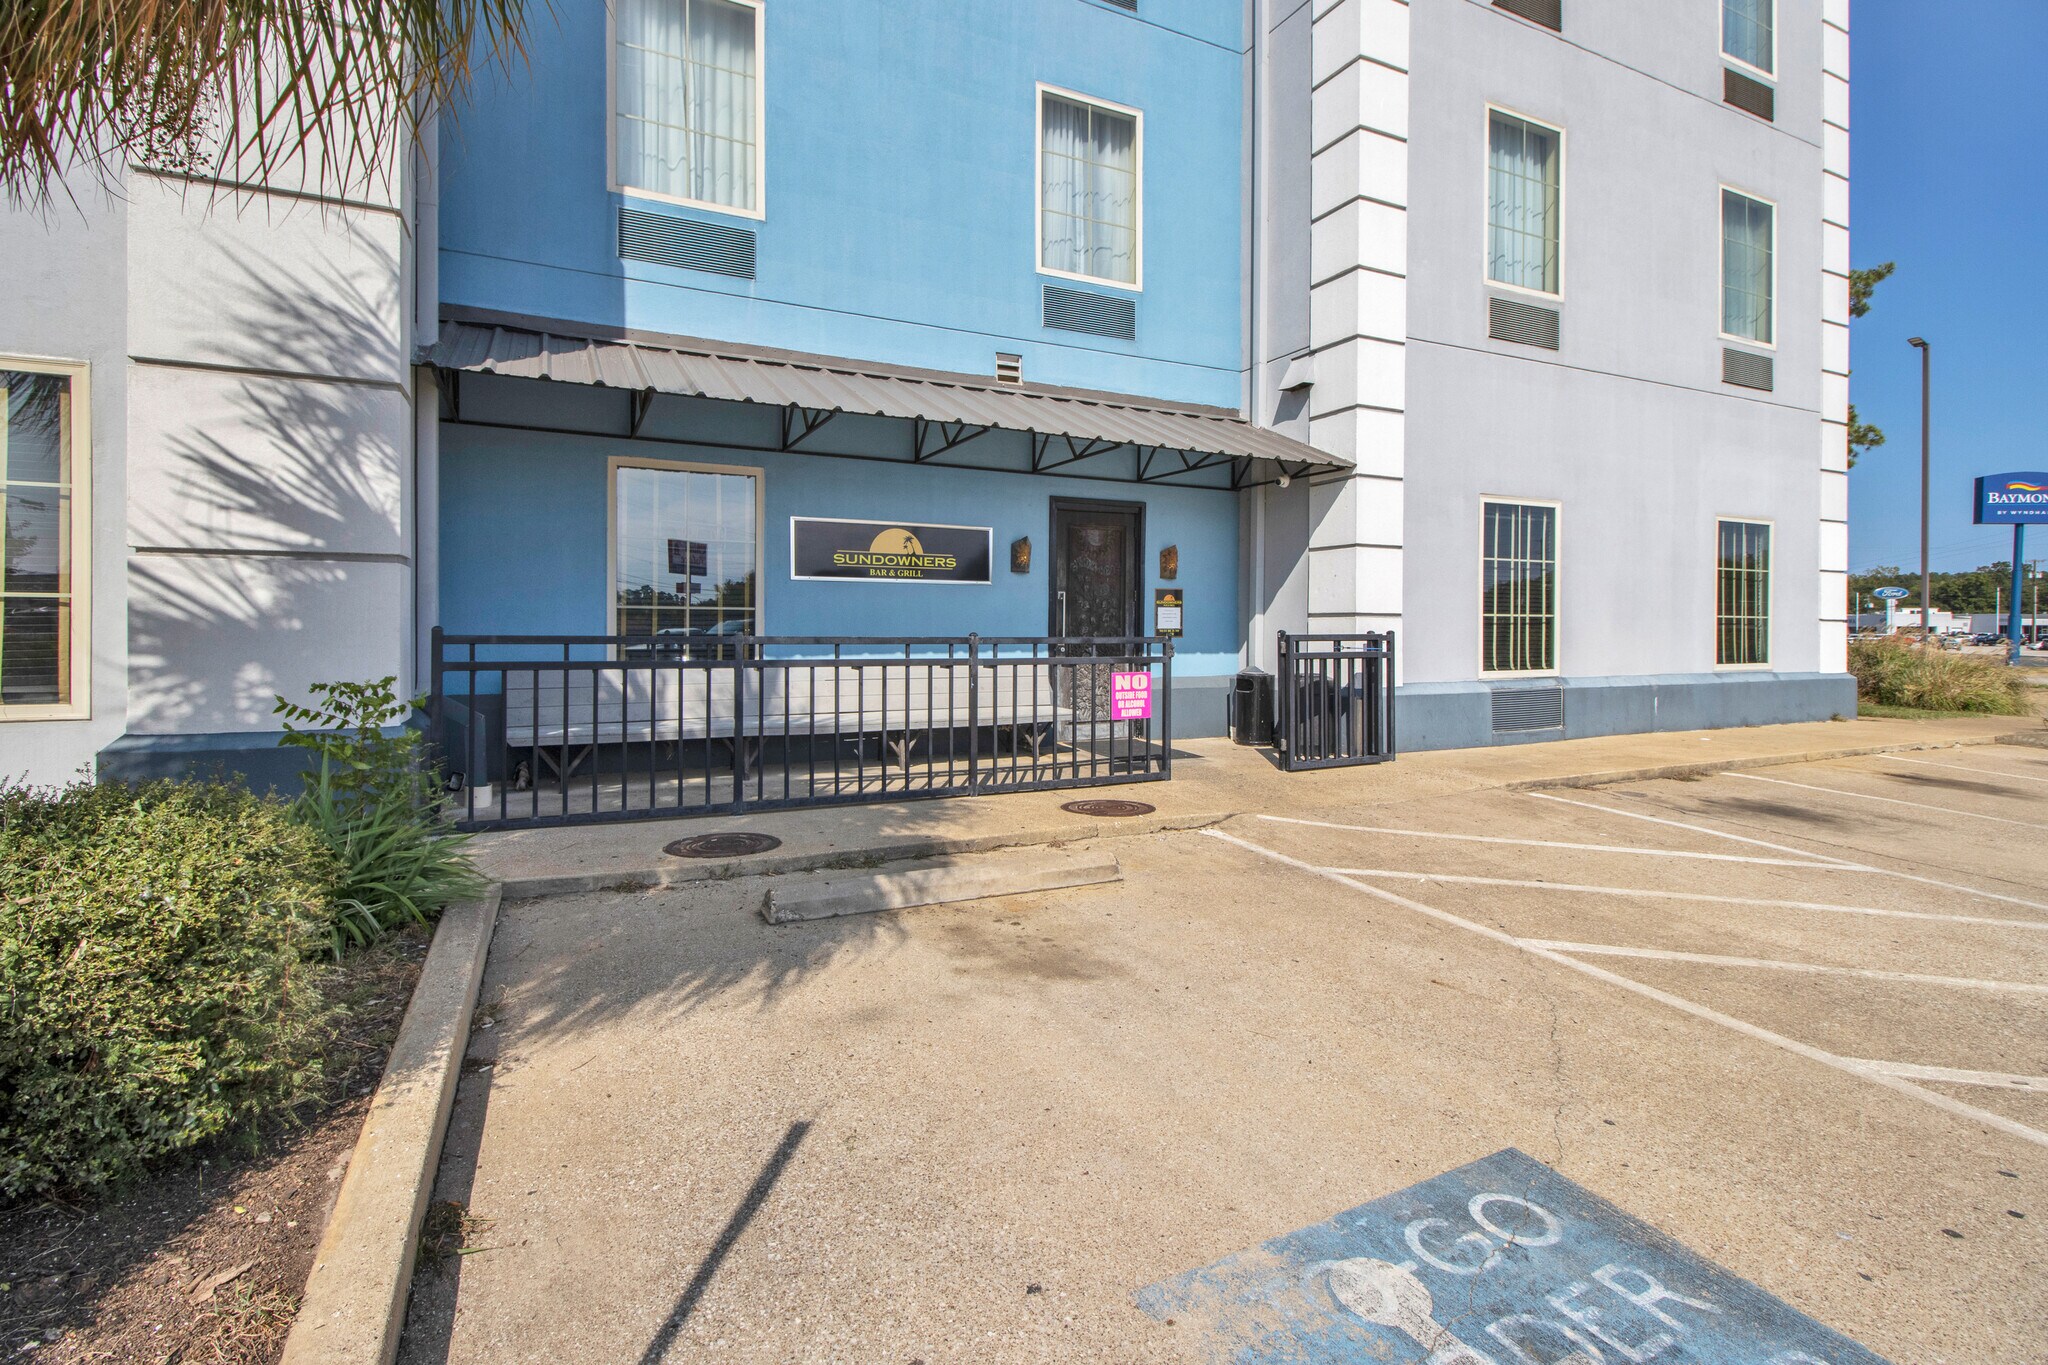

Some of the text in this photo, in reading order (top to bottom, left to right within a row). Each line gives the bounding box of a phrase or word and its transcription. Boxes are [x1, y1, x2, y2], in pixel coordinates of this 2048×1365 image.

[833, 553, 957, 568] SUNDOWNERS
[870, 568, 923, 578] BAR & GRILL
[1115, 674, 1148, 690] NO
[1115, 690, 1148, 700] OUTSIDE FOOD
